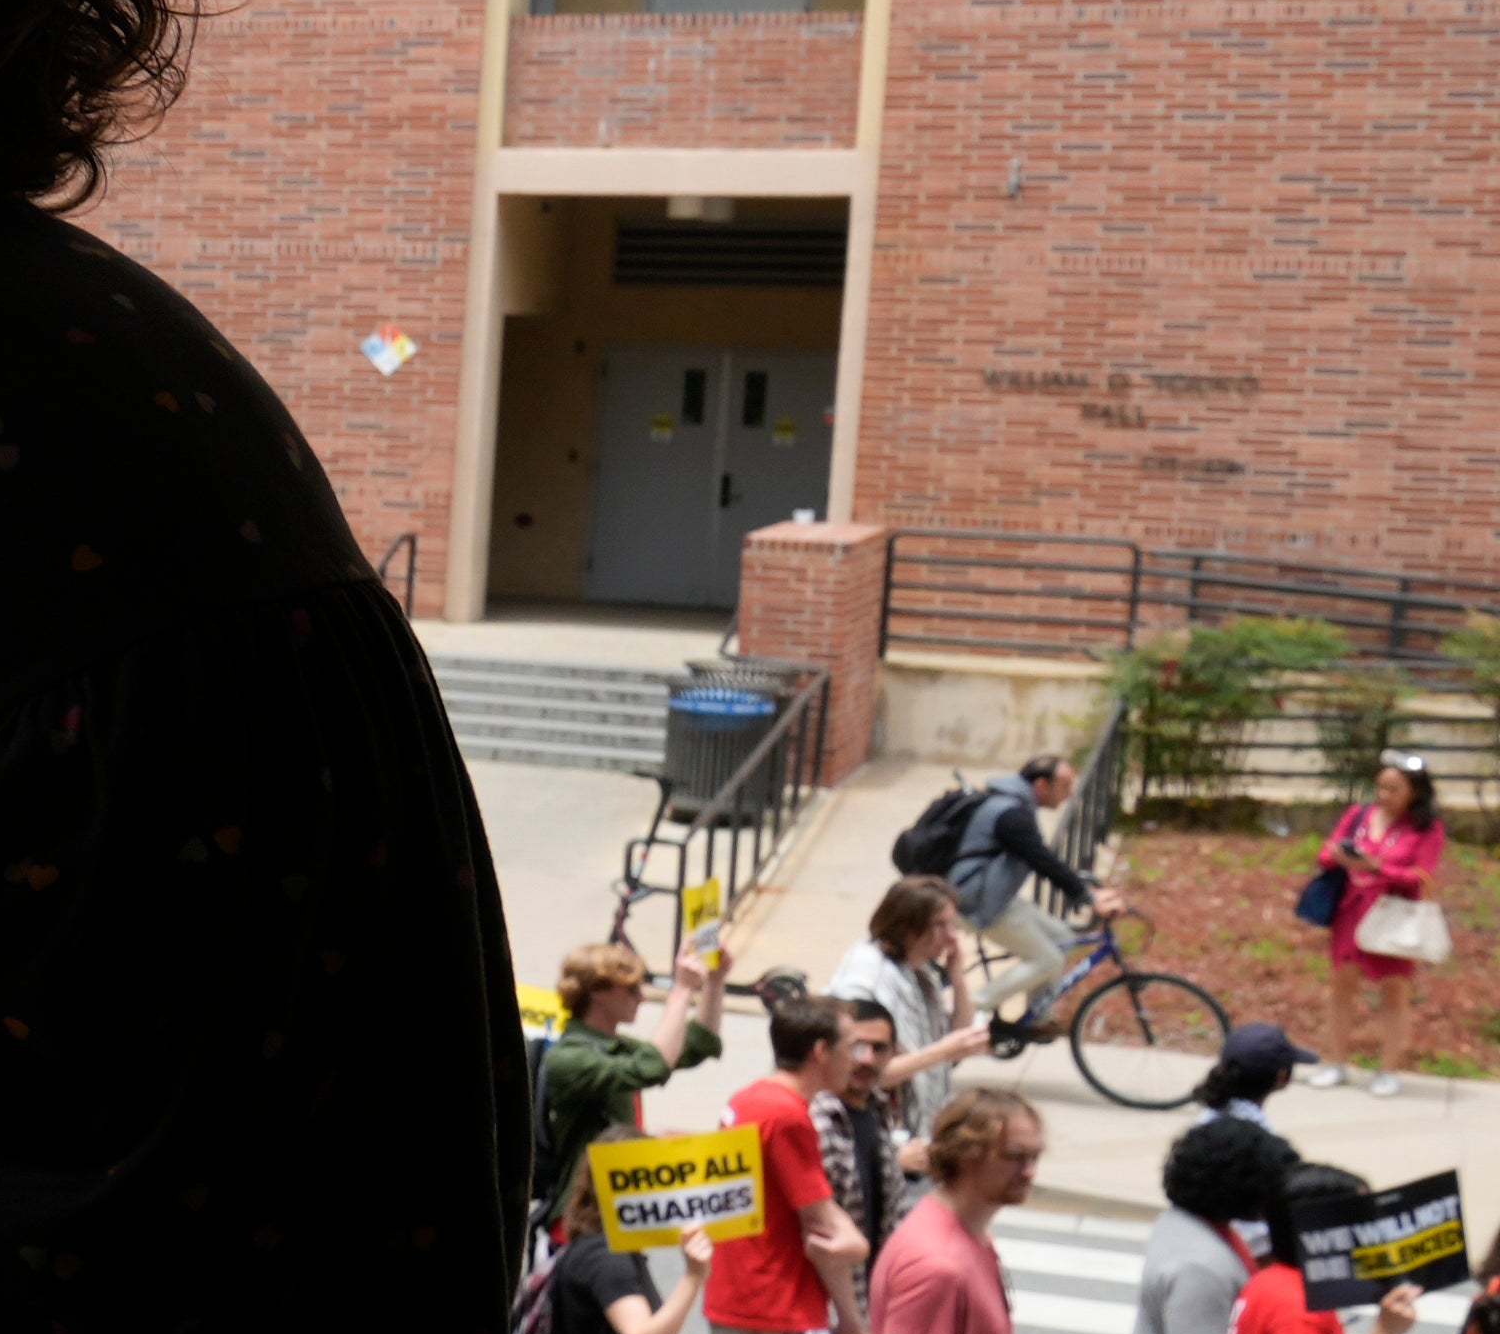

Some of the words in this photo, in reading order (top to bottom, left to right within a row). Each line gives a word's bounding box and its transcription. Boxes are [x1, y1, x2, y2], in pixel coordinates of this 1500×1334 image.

[609, 1161, 697, 1192] DROP
[705, 1151, 752, 1181] ALL
[617, 1185, 753, 1226] CHARGES
[1301, 1225, 1354, 1255] WE
[1353, 1211, 1417, 1247] WILL
[1414, 1194, 1460, 1227] NOT
